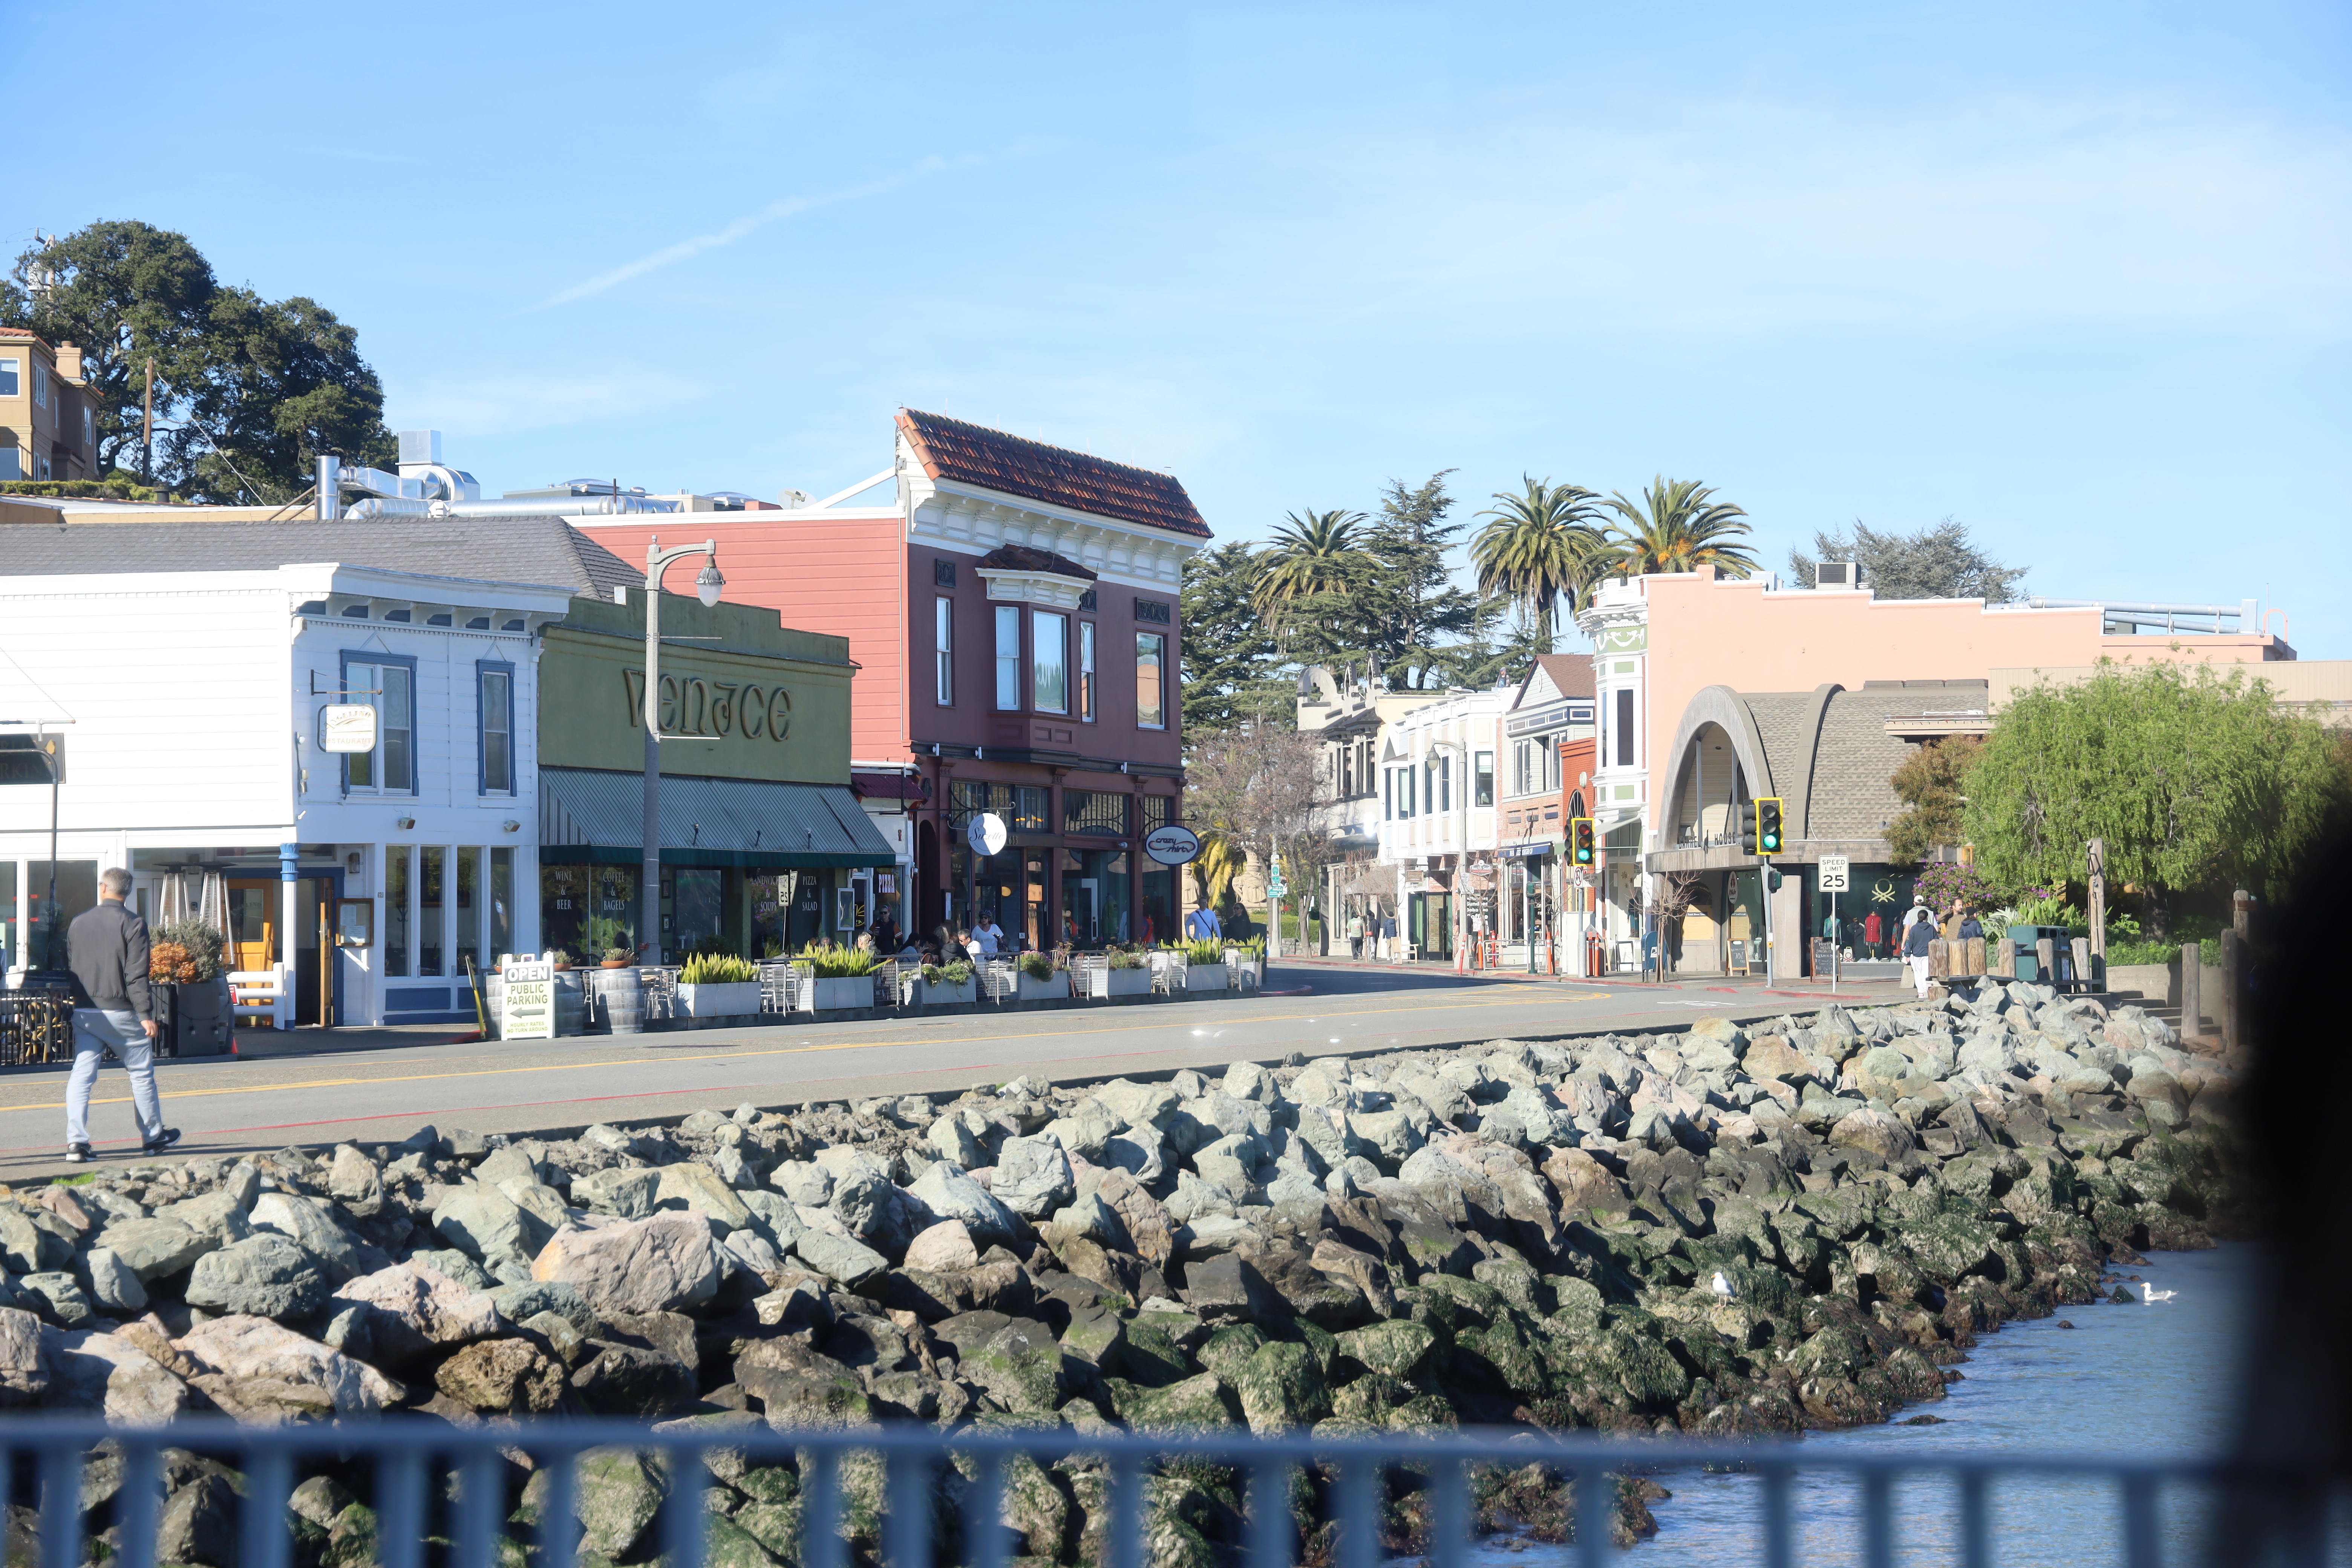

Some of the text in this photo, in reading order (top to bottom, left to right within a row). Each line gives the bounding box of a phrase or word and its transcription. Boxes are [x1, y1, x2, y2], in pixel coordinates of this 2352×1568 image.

[969, 827, 1004, 841] Suzette
[1715, 831, 1736, 845] HOUSE
[1009, 836, 1018, 844] 633
[556, 871, 572, 881] WINE
[603, 872, 625, 882] COFFEE
[803, 876, 816, 885] PIZZA
[1823, 875, 1844, 887] 25
[879, 874, 895, 893] PIZZA
[561, 885, 566, 895] &
[611, 886, 616, 896] &
[766, 889, 770, 898] &
[807, 889, 811, 898] &
[557, 900, 572, 910] BEER
[604, 900, 625, 910] BAGELS
[761, 901, 777, 911] SOUPS
[802, 902, 817, 911] SALAD
[508, 967, 547, 981] OPEN
[511, 984, 544, 995] PUBLIC
[507, 994, 548, 1006] PARKING
